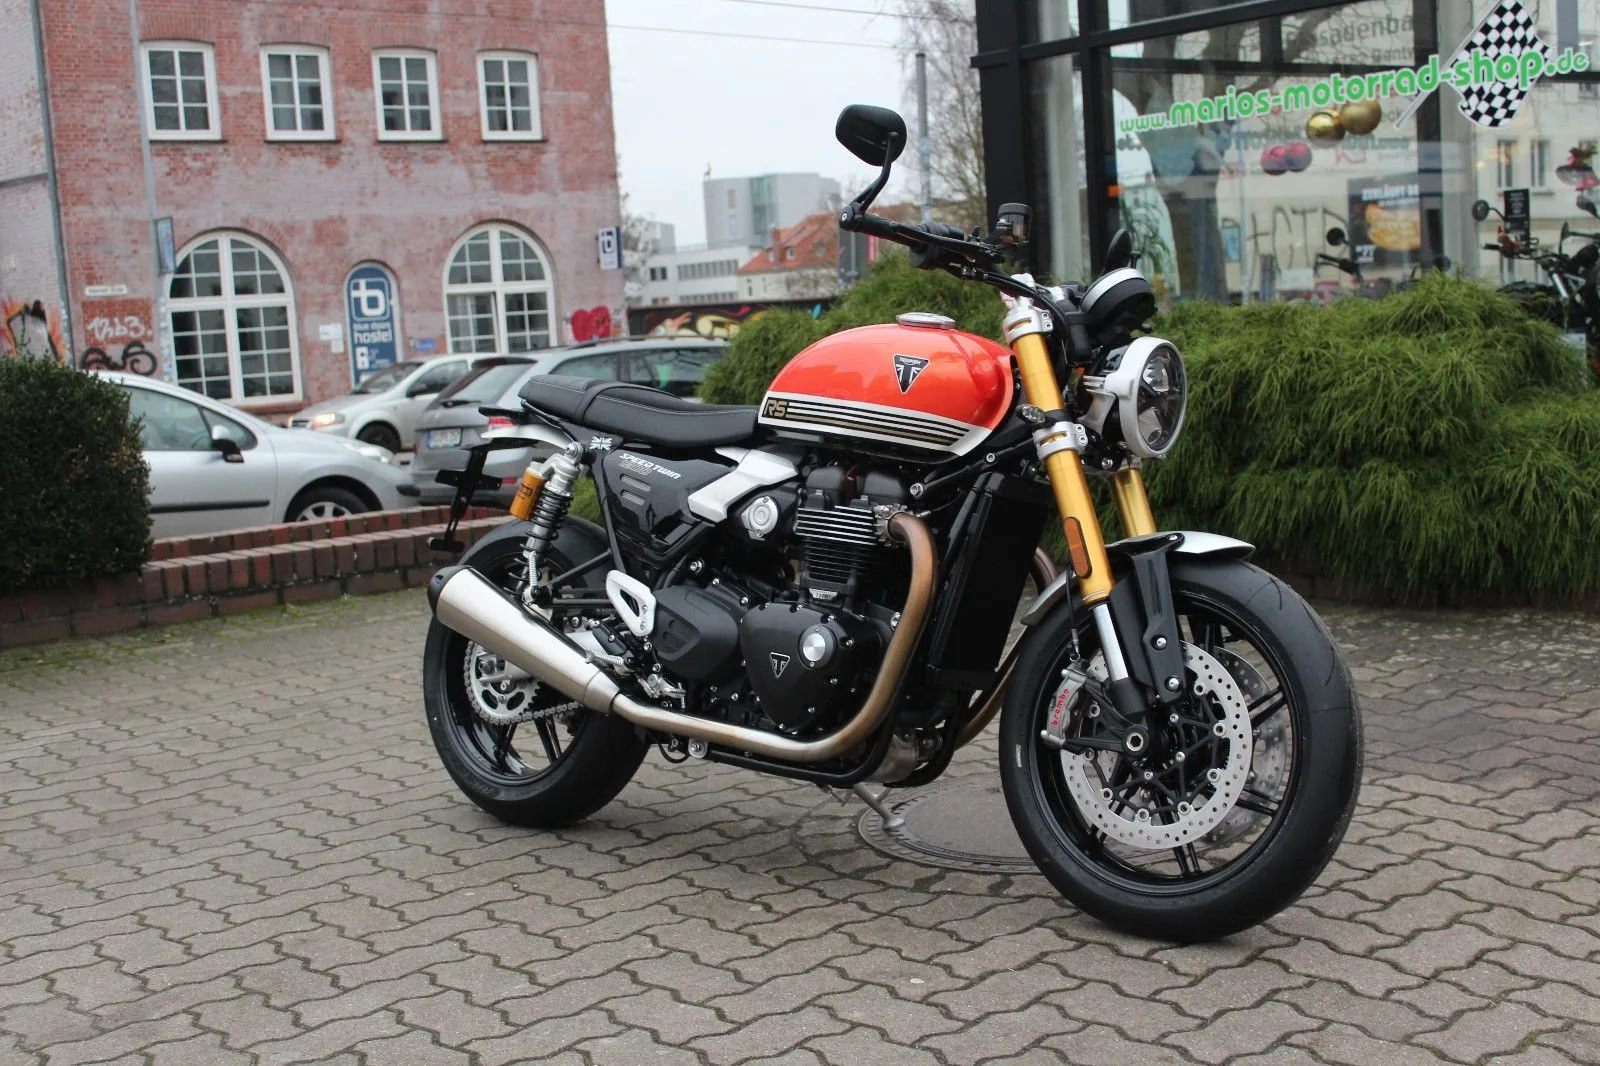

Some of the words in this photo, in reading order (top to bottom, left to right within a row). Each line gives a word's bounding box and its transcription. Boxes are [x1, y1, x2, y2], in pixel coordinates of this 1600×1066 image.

[1119, 48, 1590, 134] www.marios-motorrad-shop.de
[763, 399, 787, 417] RS
[619, 453, 654, 468] SPEED
[652, 464, 682, 480] TWIN
[1051, 688, 1070, 727] brembo
